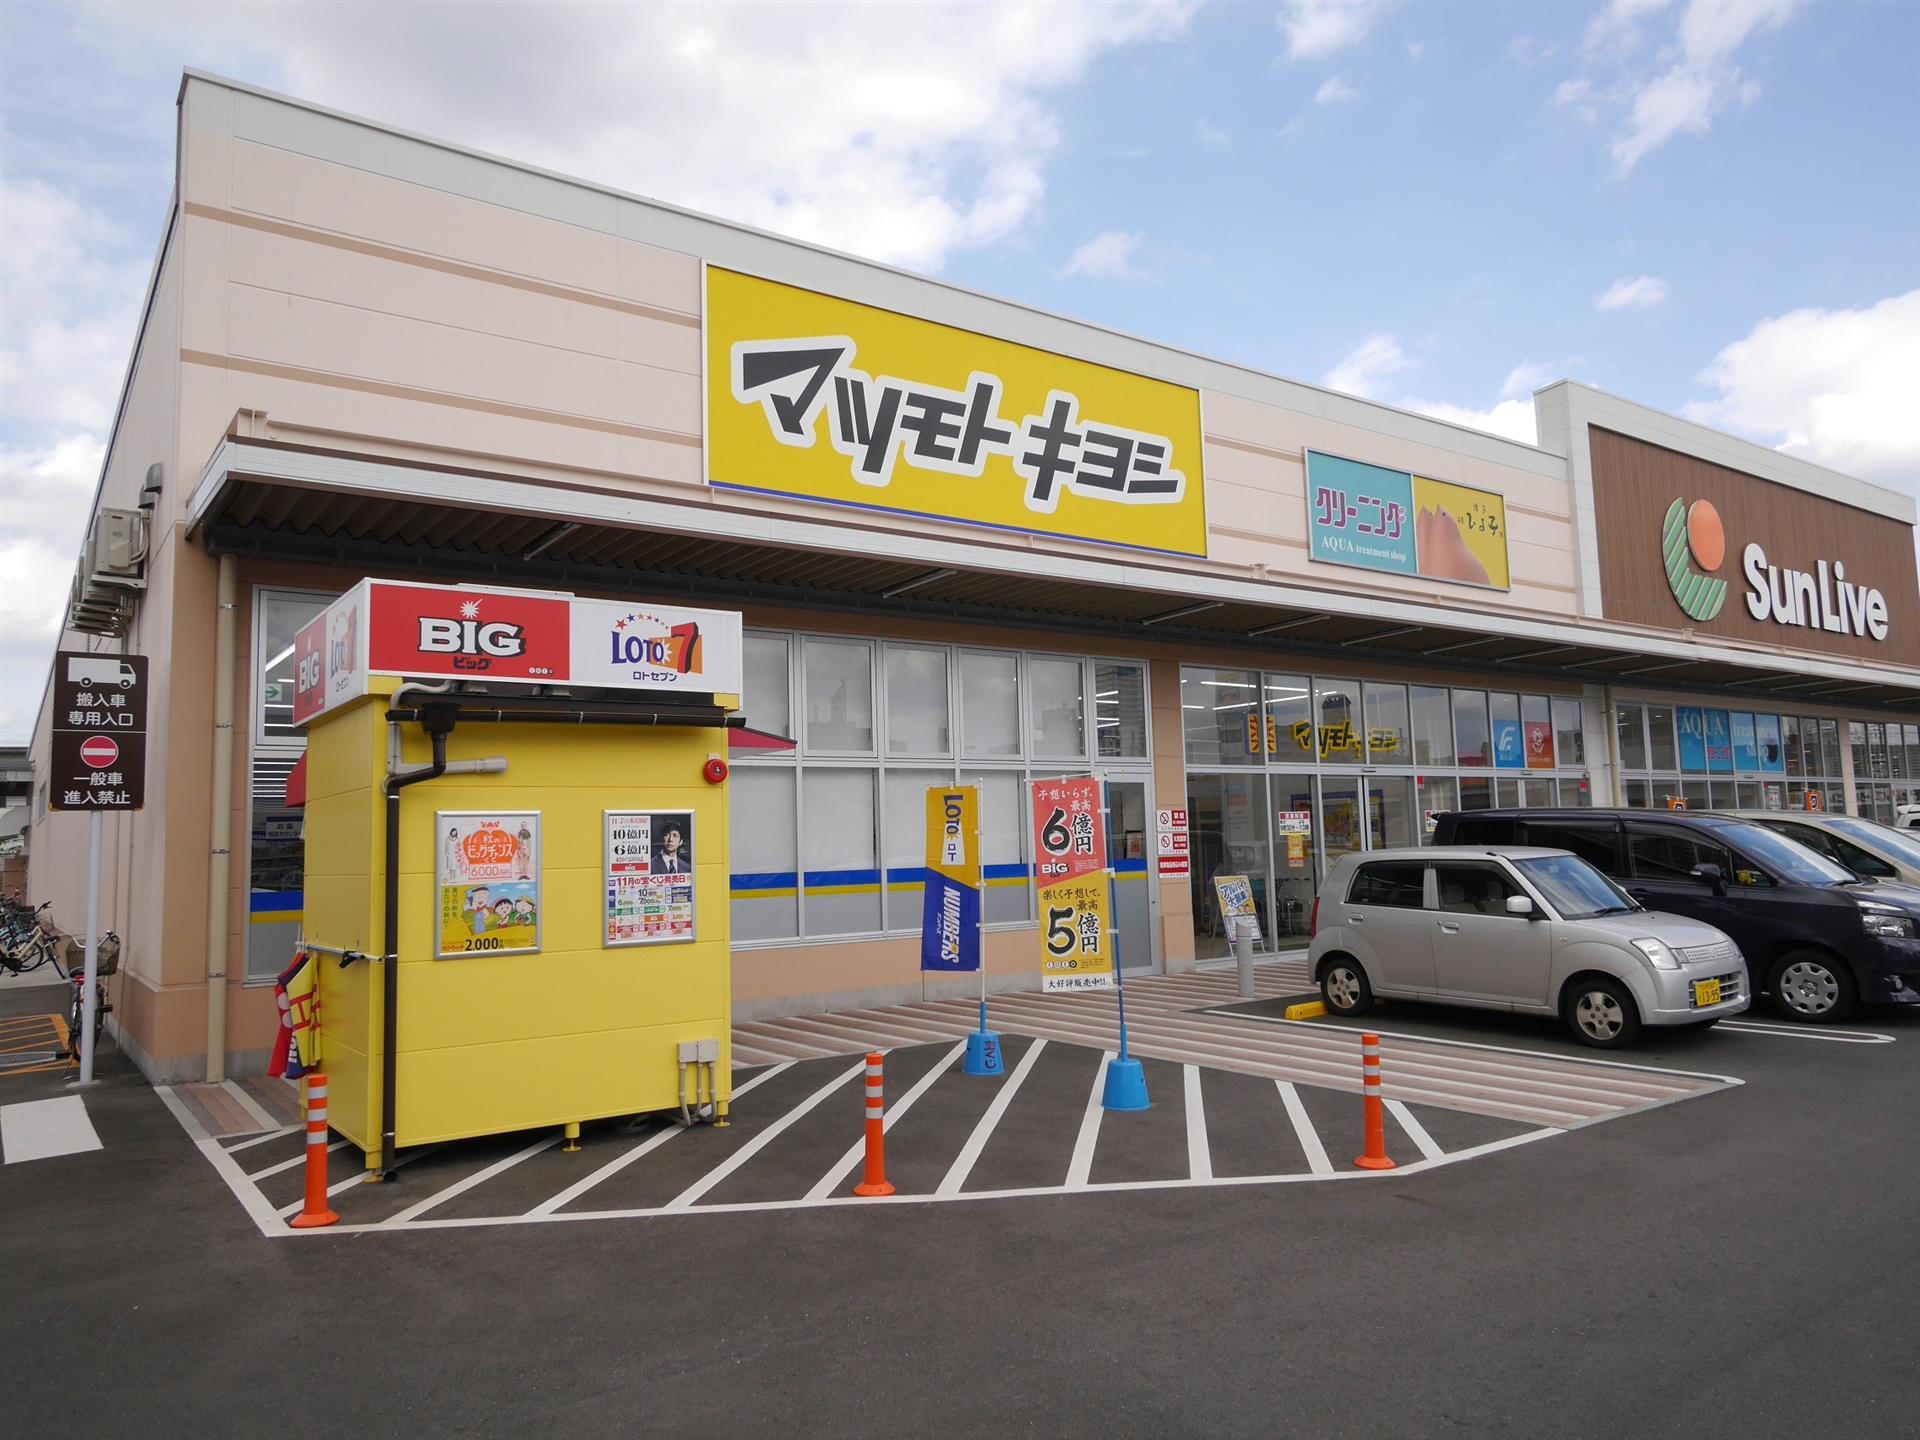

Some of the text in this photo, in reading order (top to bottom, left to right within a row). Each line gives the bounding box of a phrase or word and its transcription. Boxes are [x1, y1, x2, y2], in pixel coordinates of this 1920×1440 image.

[738, 343, 1183, 506] マツモトキヨシ
[1316, 486, 1406, 540] クリーニング
[1322, 535, 1407, 564] AQUA treatment shop
[1743, 542, 1889, 641] SunLive
[418, 616, 526, 657] BIG
[611, 631, 665, 664] LOTO
[299, 650, 321, 695] BIG
[453, 656, 492, 671] ビッグ
[632, 671, 678, 682] ロトセブン
[76, 692, 127, 707] 搬入車
[67, 711, 134, 726] 専用入口
[1292, 717, 1400, 757] マツモトヨシ
[73, 772, 123, 786] 一般車
[63, 790, 131, 805] 進入禁止
[1070, 799, 1092, 812] 最高
[1041, 862, 1069, 876] BIG
[1076, 899, 1098, 912] 最高
[940, 885, 961, 964] NUMBERS
